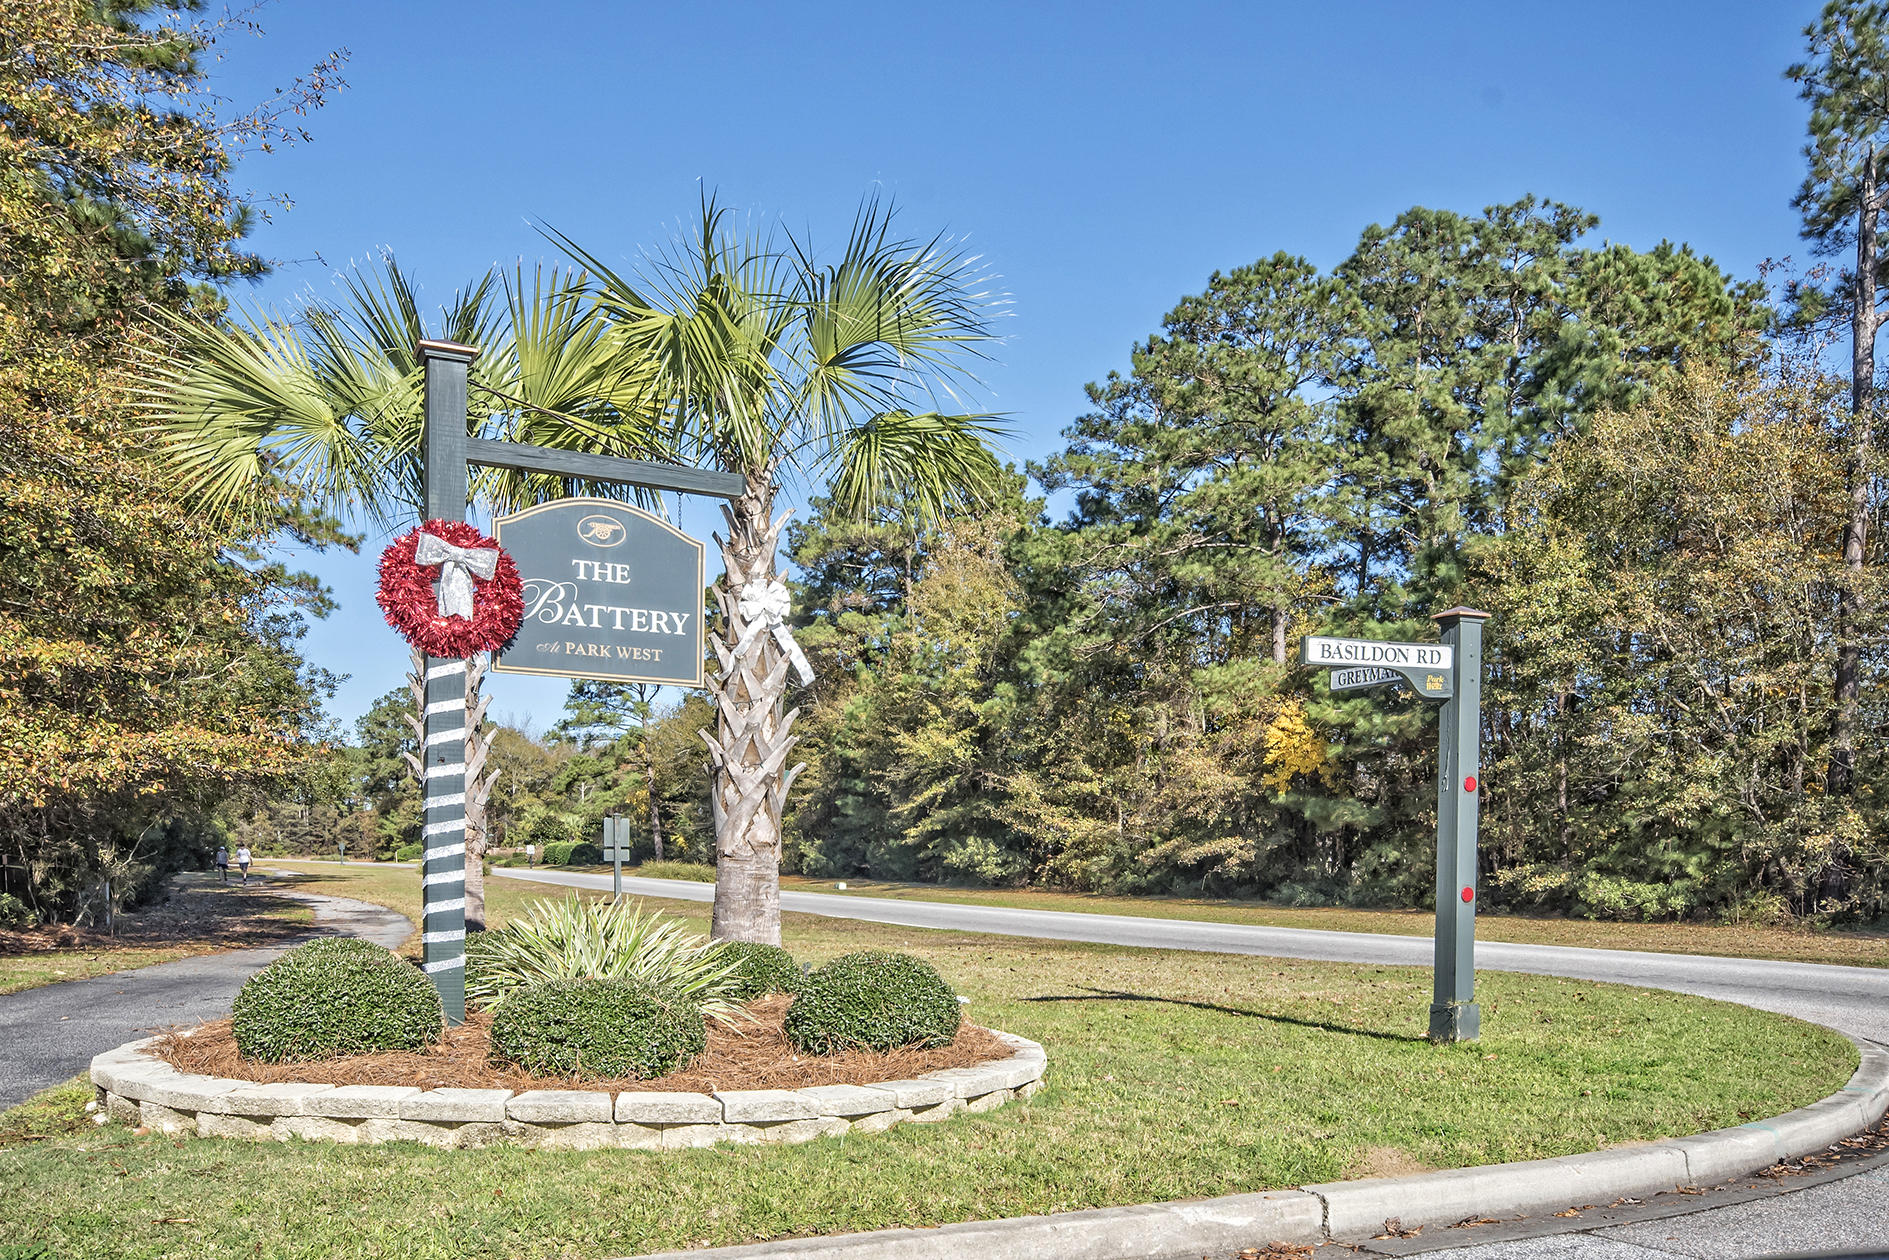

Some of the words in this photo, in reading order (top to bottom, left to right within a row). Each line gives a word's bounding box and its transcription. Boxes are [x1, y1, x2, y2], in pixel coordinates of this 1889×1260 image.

[571, 559, 631, 584] THE
[521, 578, 690, 636] BATTERY
[565, 641, 612, 658] PARK
[616, 646, 664, 662] WEST
[1320, 643, 1409, 663] BASILDON
[1416, 649, 1441, 665] RD
